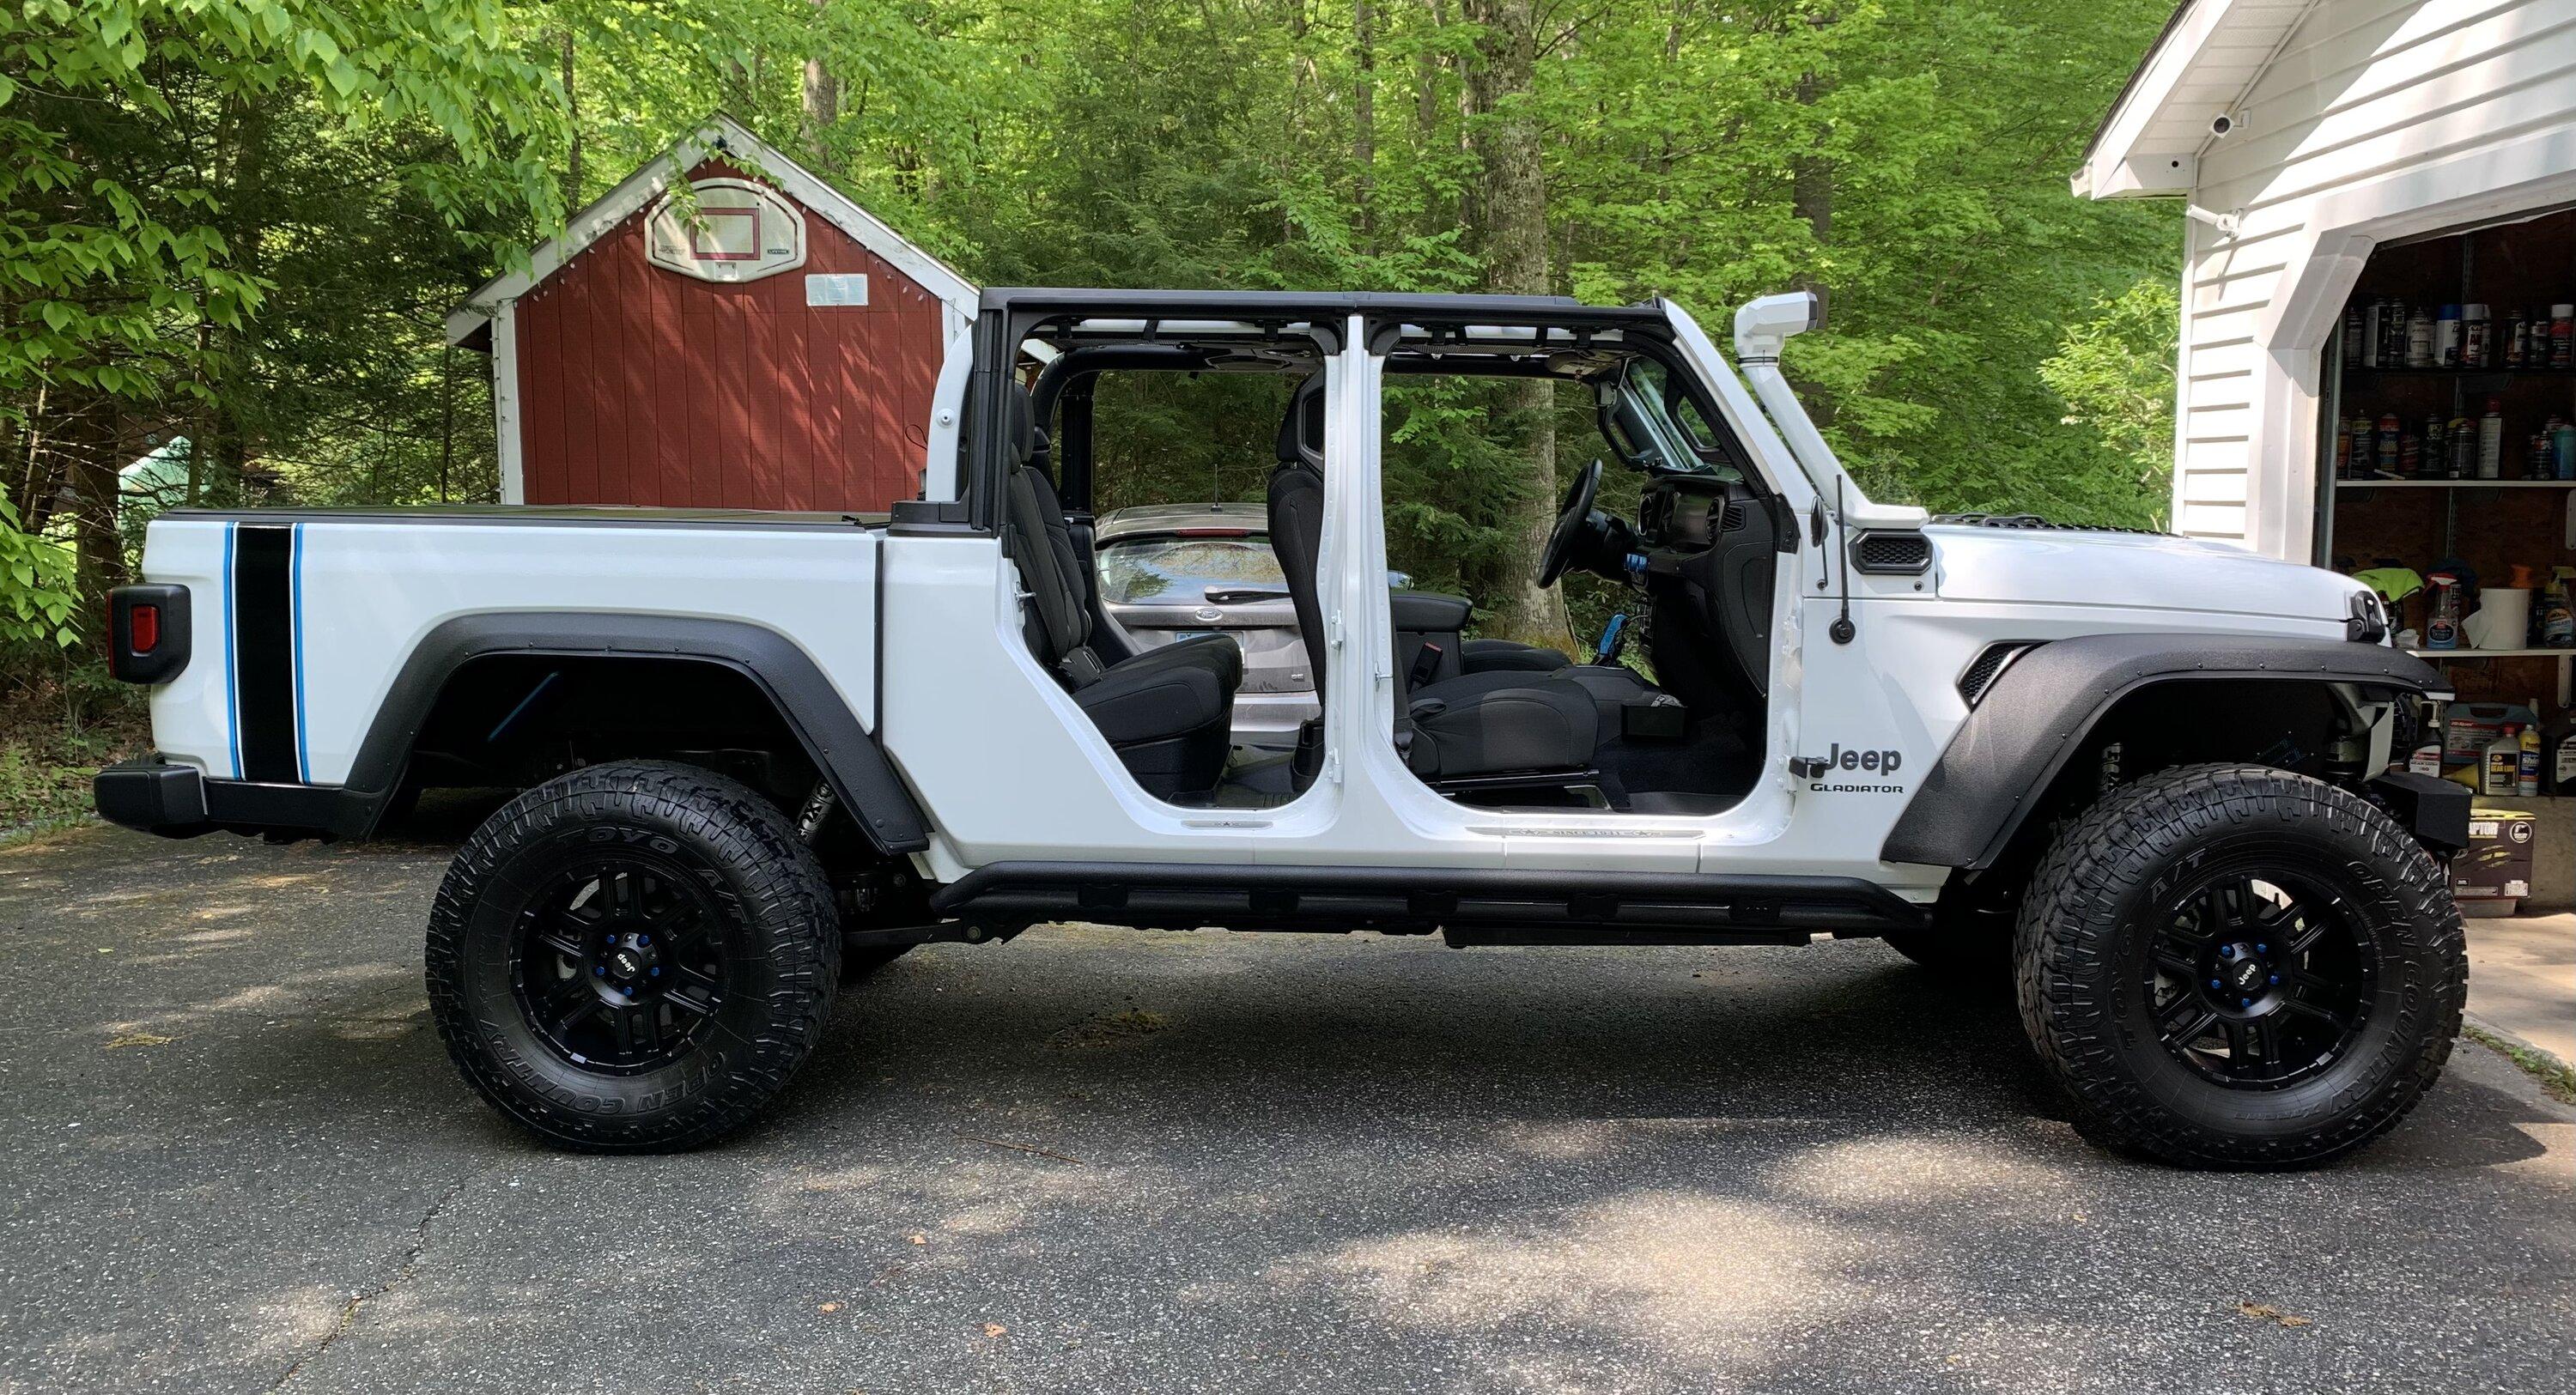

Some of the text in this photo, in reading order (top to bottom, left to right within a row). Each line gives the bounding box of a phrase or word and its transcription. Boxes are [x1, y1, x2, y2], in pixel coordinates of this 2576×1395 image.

[1825, 743, 1902, 776] Jeep
[1810, 783, 1904, 793] GLADIATOR
[552, 825, 679, 854] TOYO
[617, 953, 635, 972] Jeep
[2238, 963, 2257, 986] Jeep
[478, 1019, 726, 1115] OPEN COUNTRY
